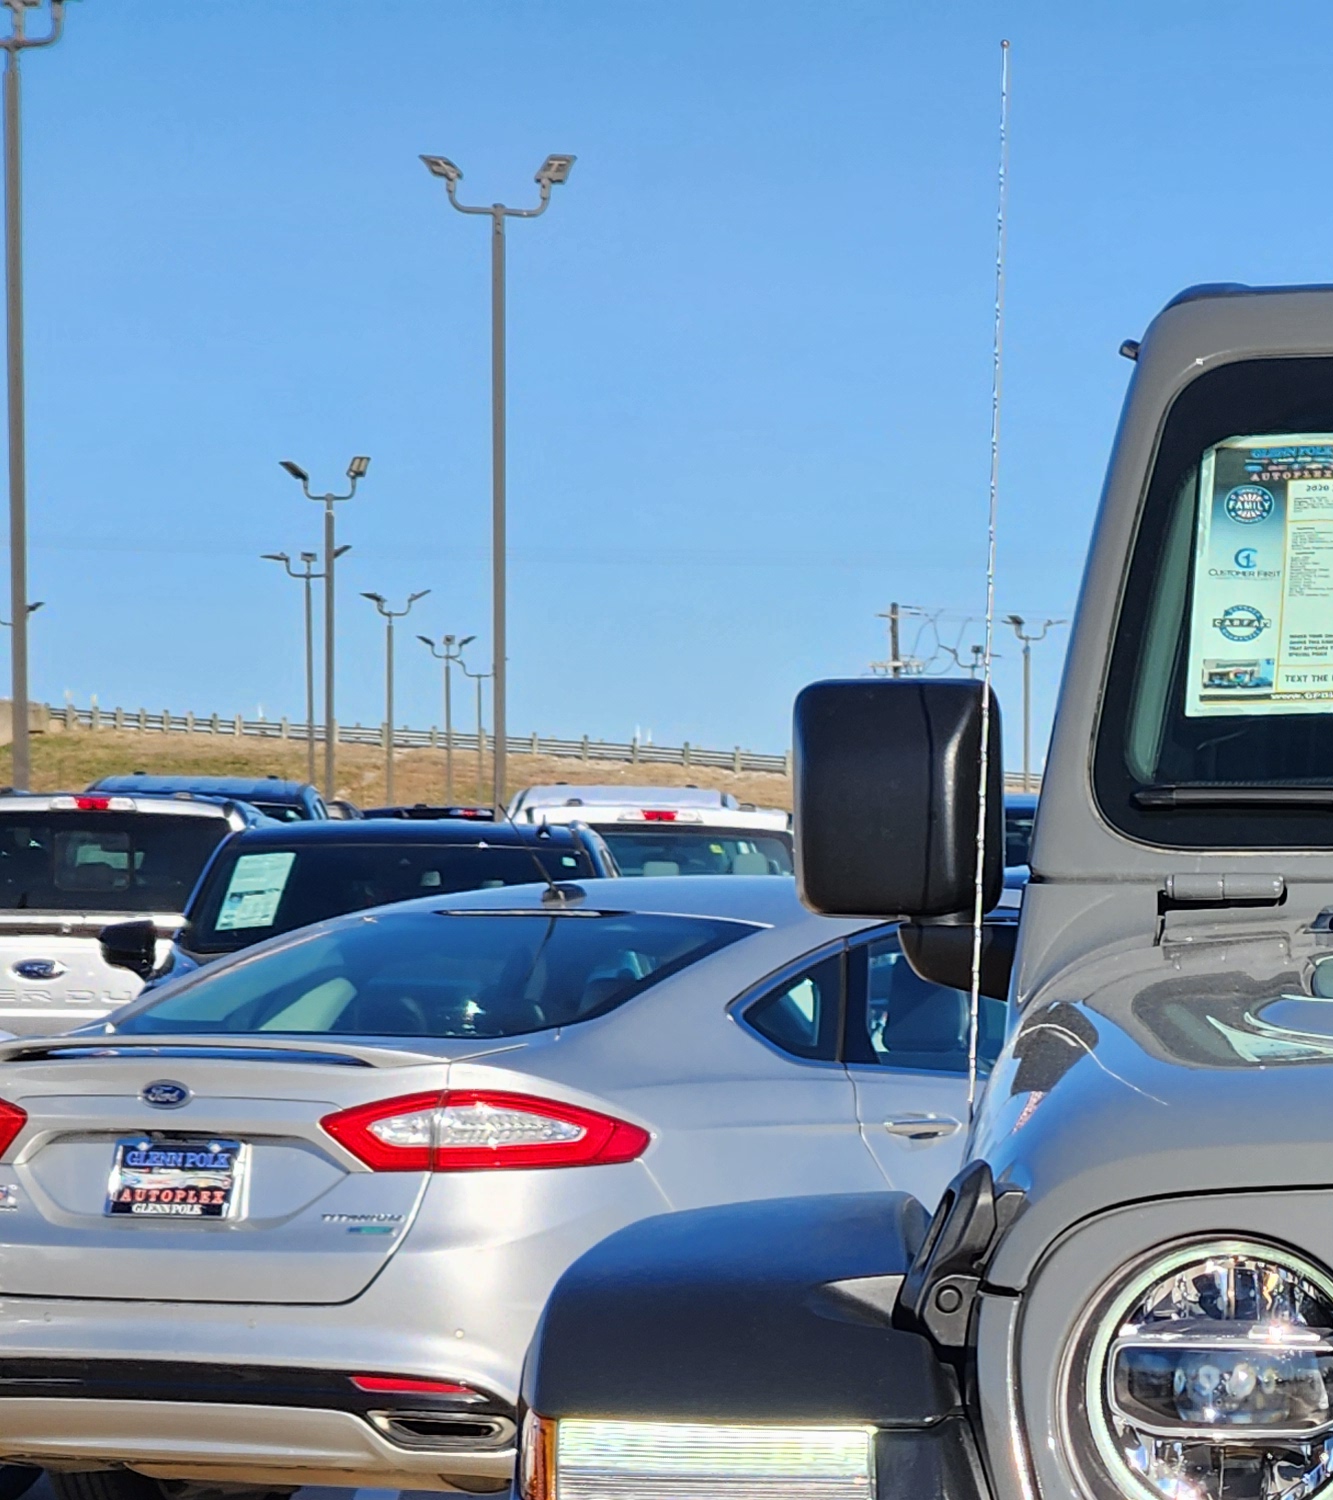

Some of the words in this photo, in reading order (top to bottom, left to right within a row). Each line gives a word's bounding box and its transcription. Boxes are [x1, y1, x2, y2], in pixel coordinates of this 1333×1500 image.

[1250, 470, 1333, 481] AUTOPLEX
[1228, 500, 1271, 511] FAMILY
[1213, 618, 1272, 629] CARFAX
[1285, 674, 1308, 683] TEXT
[1311, 674, 1329, 682] THE
[126, 1151, 185, 1167] GLENN
[184, 1152, 231, 1168] POLK
[119, 1188, 226, 1205] AUTOPLEX
[131, 1202, 171, 1214] GLENN
[170, 1203, 203, 1215] POLK
